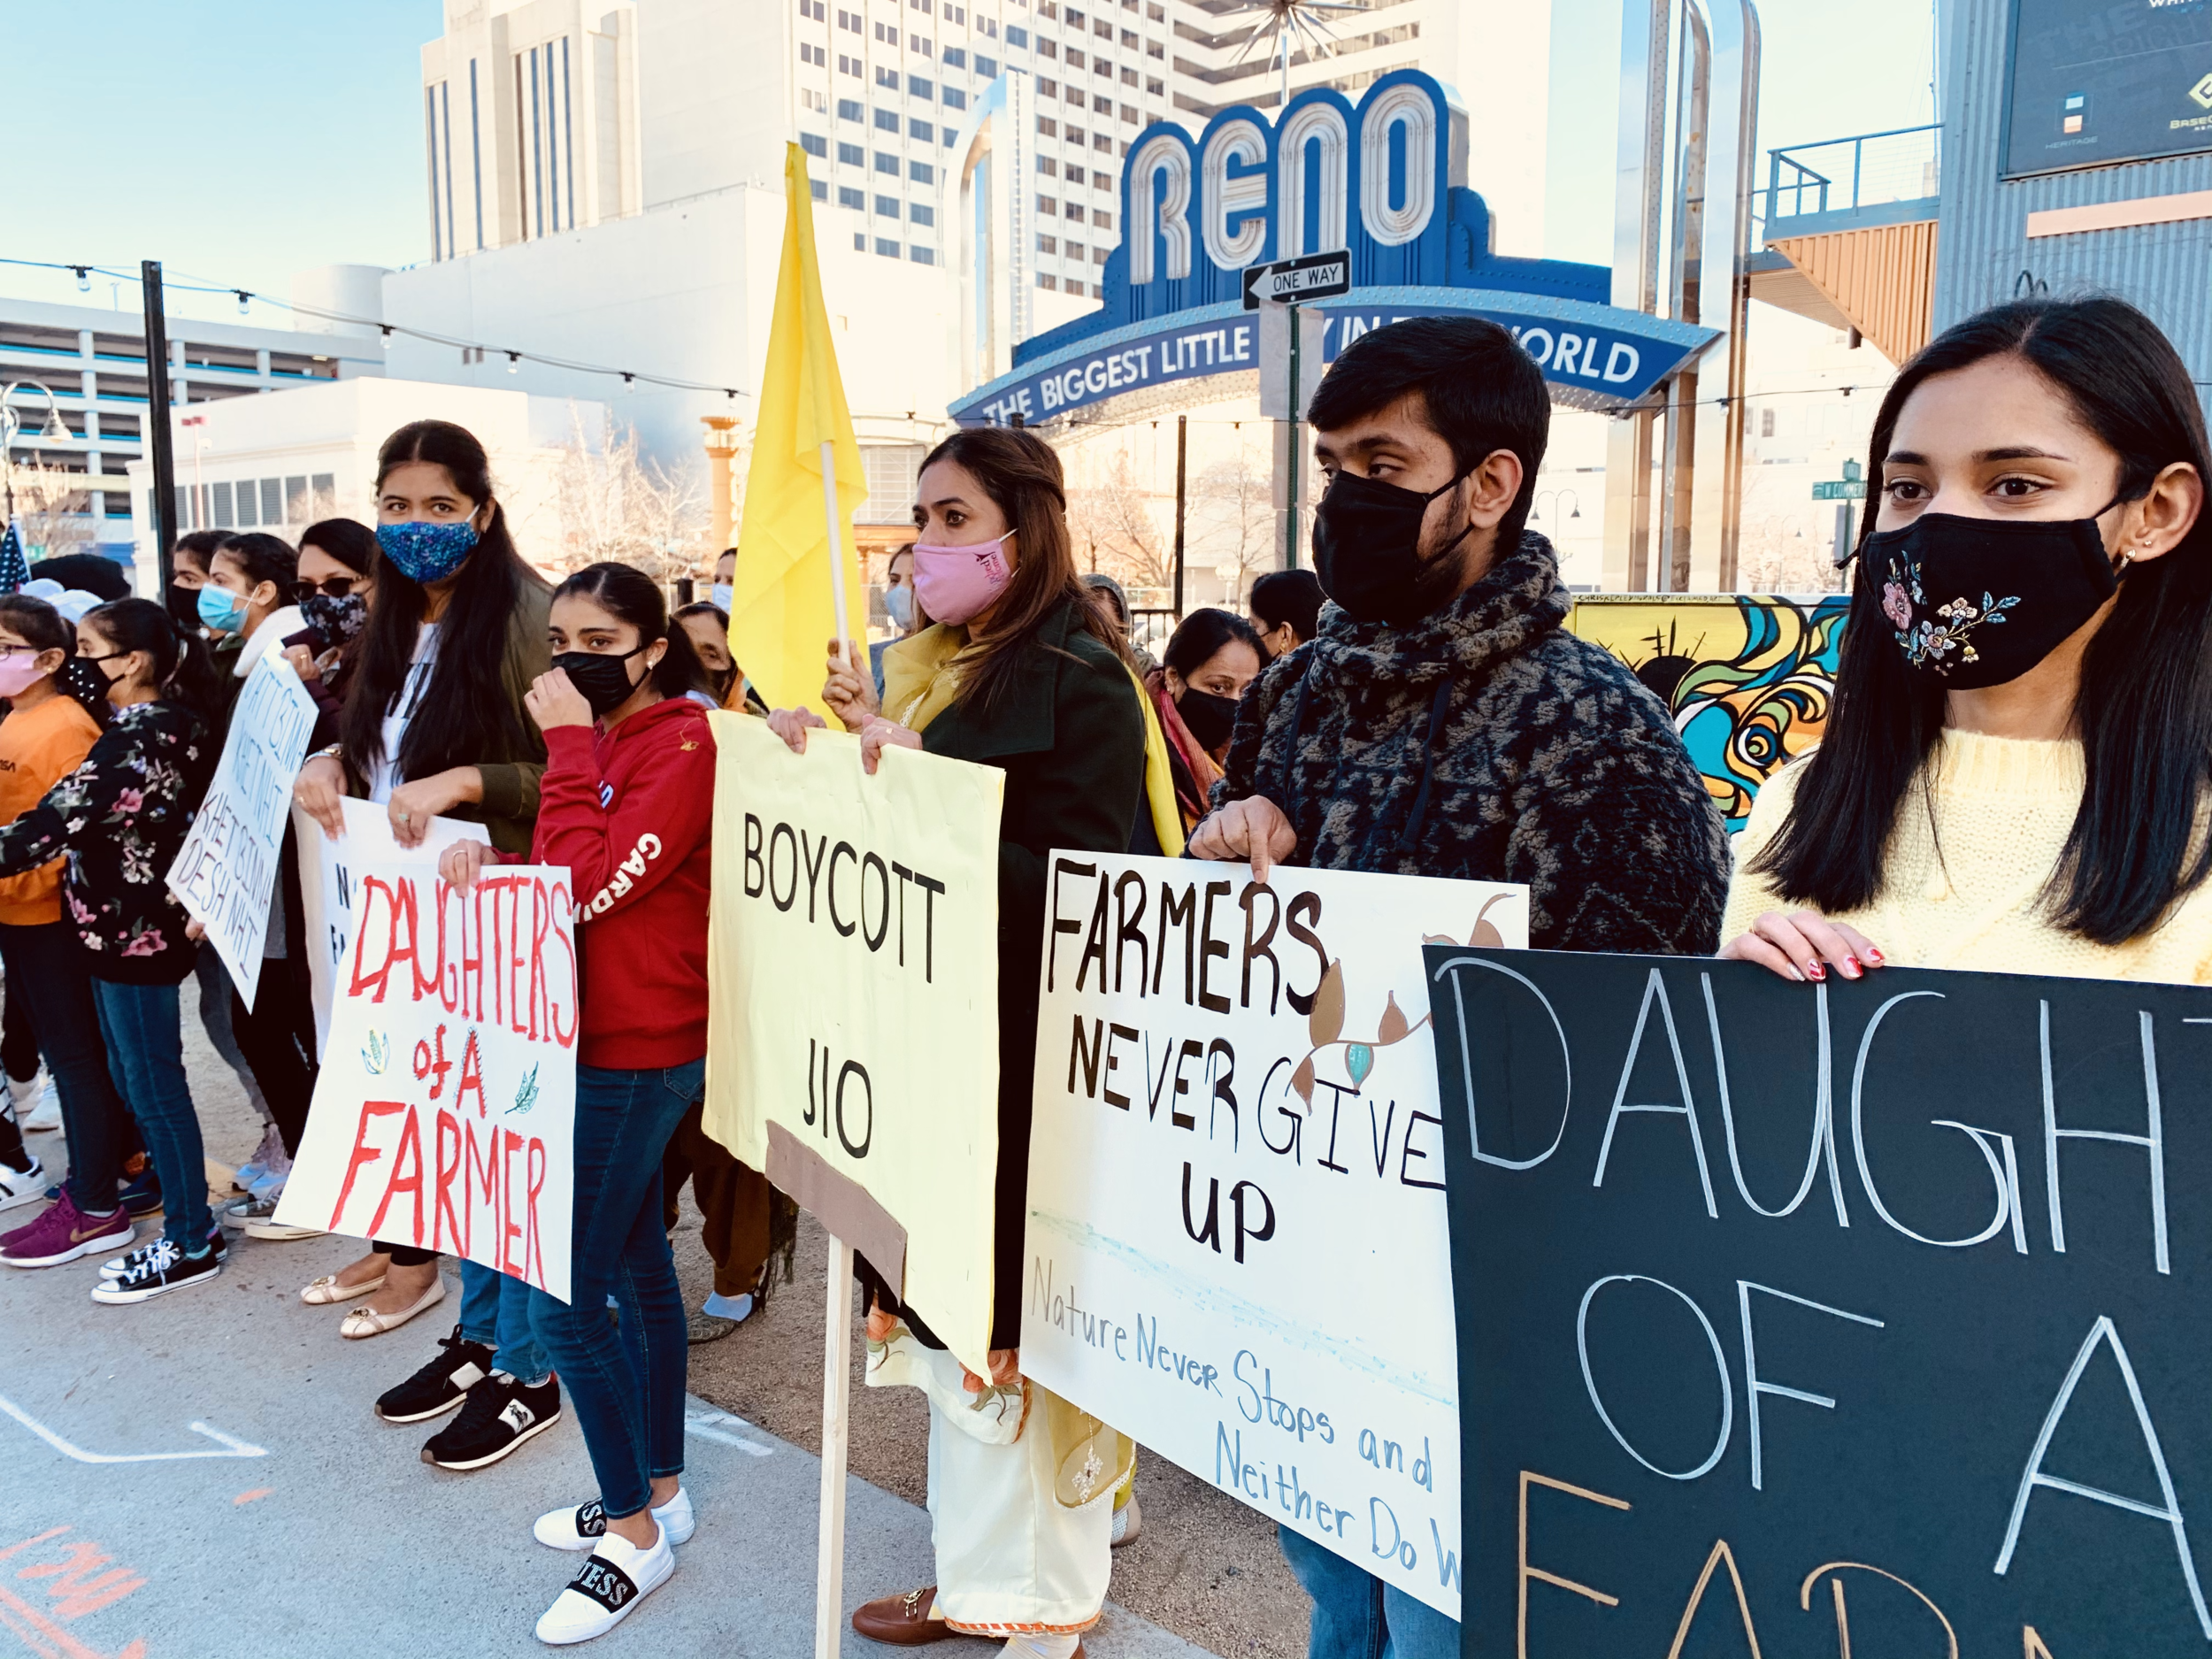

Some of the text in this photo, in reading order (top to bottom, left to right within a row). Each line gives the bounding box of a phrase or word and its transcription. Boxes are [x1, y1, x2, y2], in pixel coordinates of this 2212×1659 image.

[1129, 82, 1436, 286] RENO
[2045, 135, 2100, 150] HERITAGE
[1273, 265, 1340, 292] ONE WAY
[1040, 345, 1153, 411] BIGGEST
[1160, 326, 1251, 374] LITTLE
[1832, 482, 1868, 498] COMMER
[348, 873, 580, 1049] DAUGHTERS
[743, 811, 947, 984] BOYCOTT
[1047, 856, 1331, 1017] FARMERS
[453, 1024, 488, 1119] A
[803, 1038, 873, 1159] JIO
[1067, 1013, 1447, 1191] NEVER GIVE
[1433, 956, 2212, 1276] DAUGH
[328, 1101, 548, 1293] FARMER
[1180, 1161, 1276, 1264] UP
[1030, 1255, 1127, 1362] Nature
[1233, 1349, 1335, 1445] Stops
[1357, 1427, 1433, 1494] and
[1577, 1272, 1886, 1491] OF
[1216, 1420, 1462, 1594] Neither Do W
[1993, 1315, 2212, 1642] A
